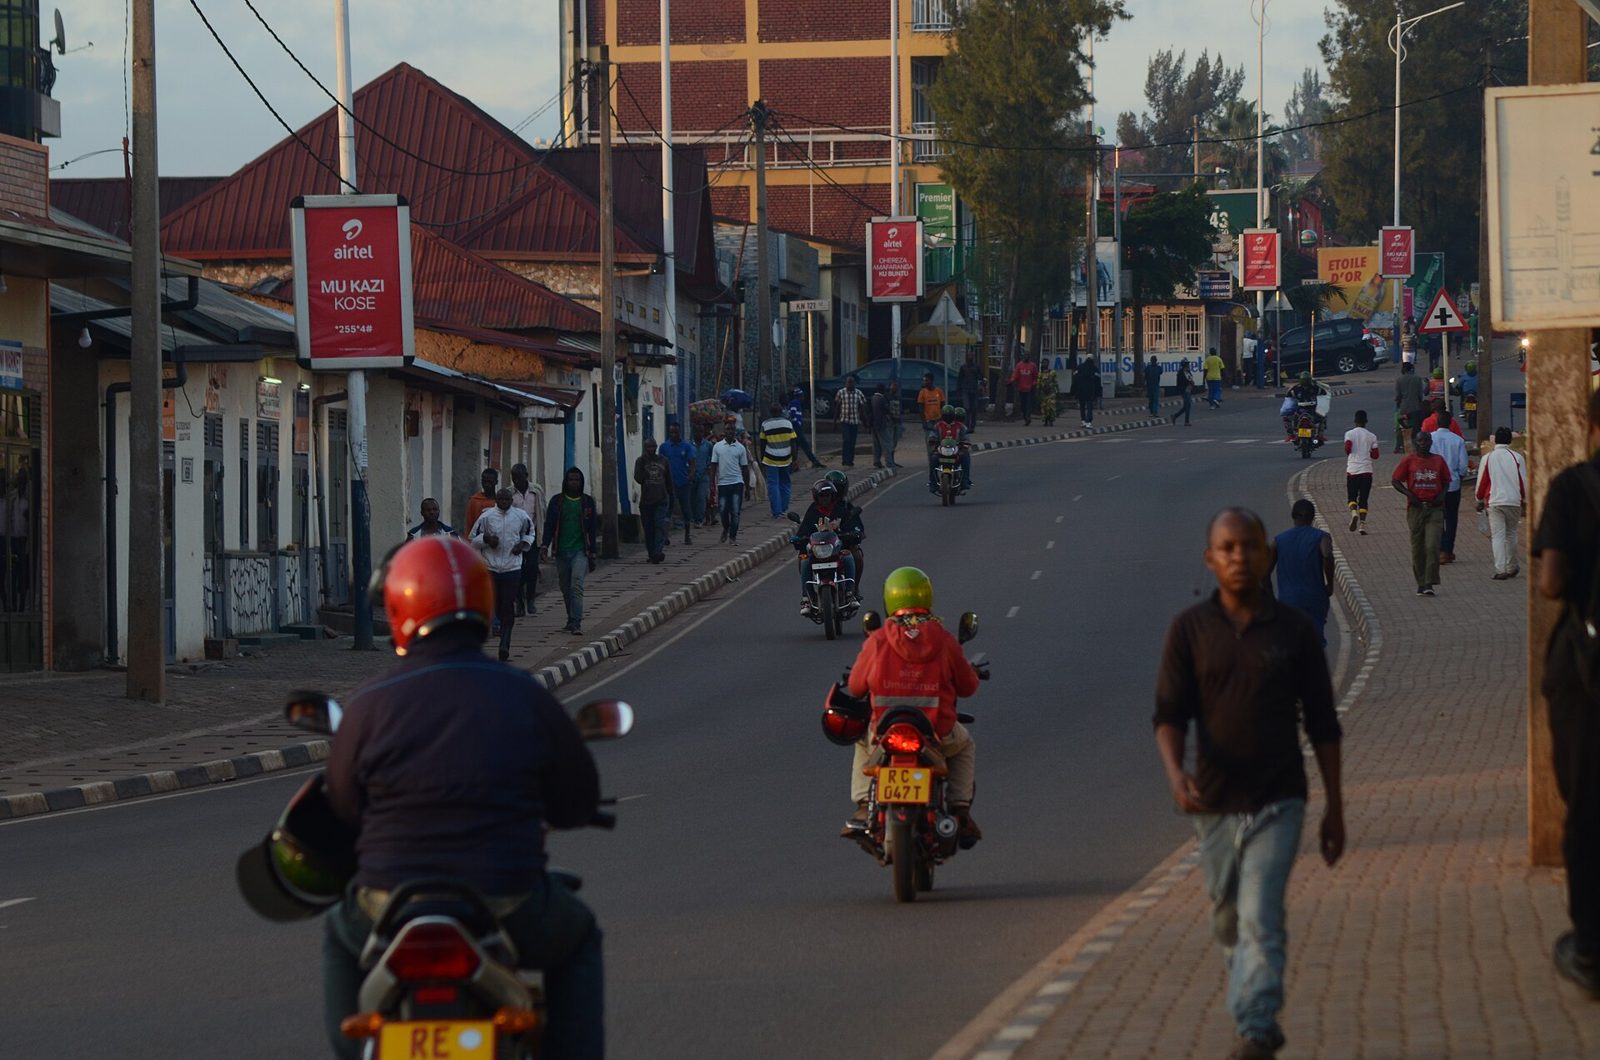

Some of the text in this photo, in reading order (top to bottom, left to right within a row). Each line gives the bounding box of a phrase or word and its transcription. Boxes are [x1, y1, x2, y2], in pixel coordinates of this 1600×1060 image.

[919, 192, 952, 202] Premier
[883, 240, 903, 248] airtel
[333, 244, 374, 260] airtel
[1328, 256, 1368, 272] ETOILE
[1331, 270, 1362, 284] D'OR
[320, 279, 385, 294] MU KAZI
[333, 296, 376, 310] KOSE
[888, 769, 910, 783] RC
[883, 785, 922, 800] 047T
[411, 1026, 449, 1057] RE
